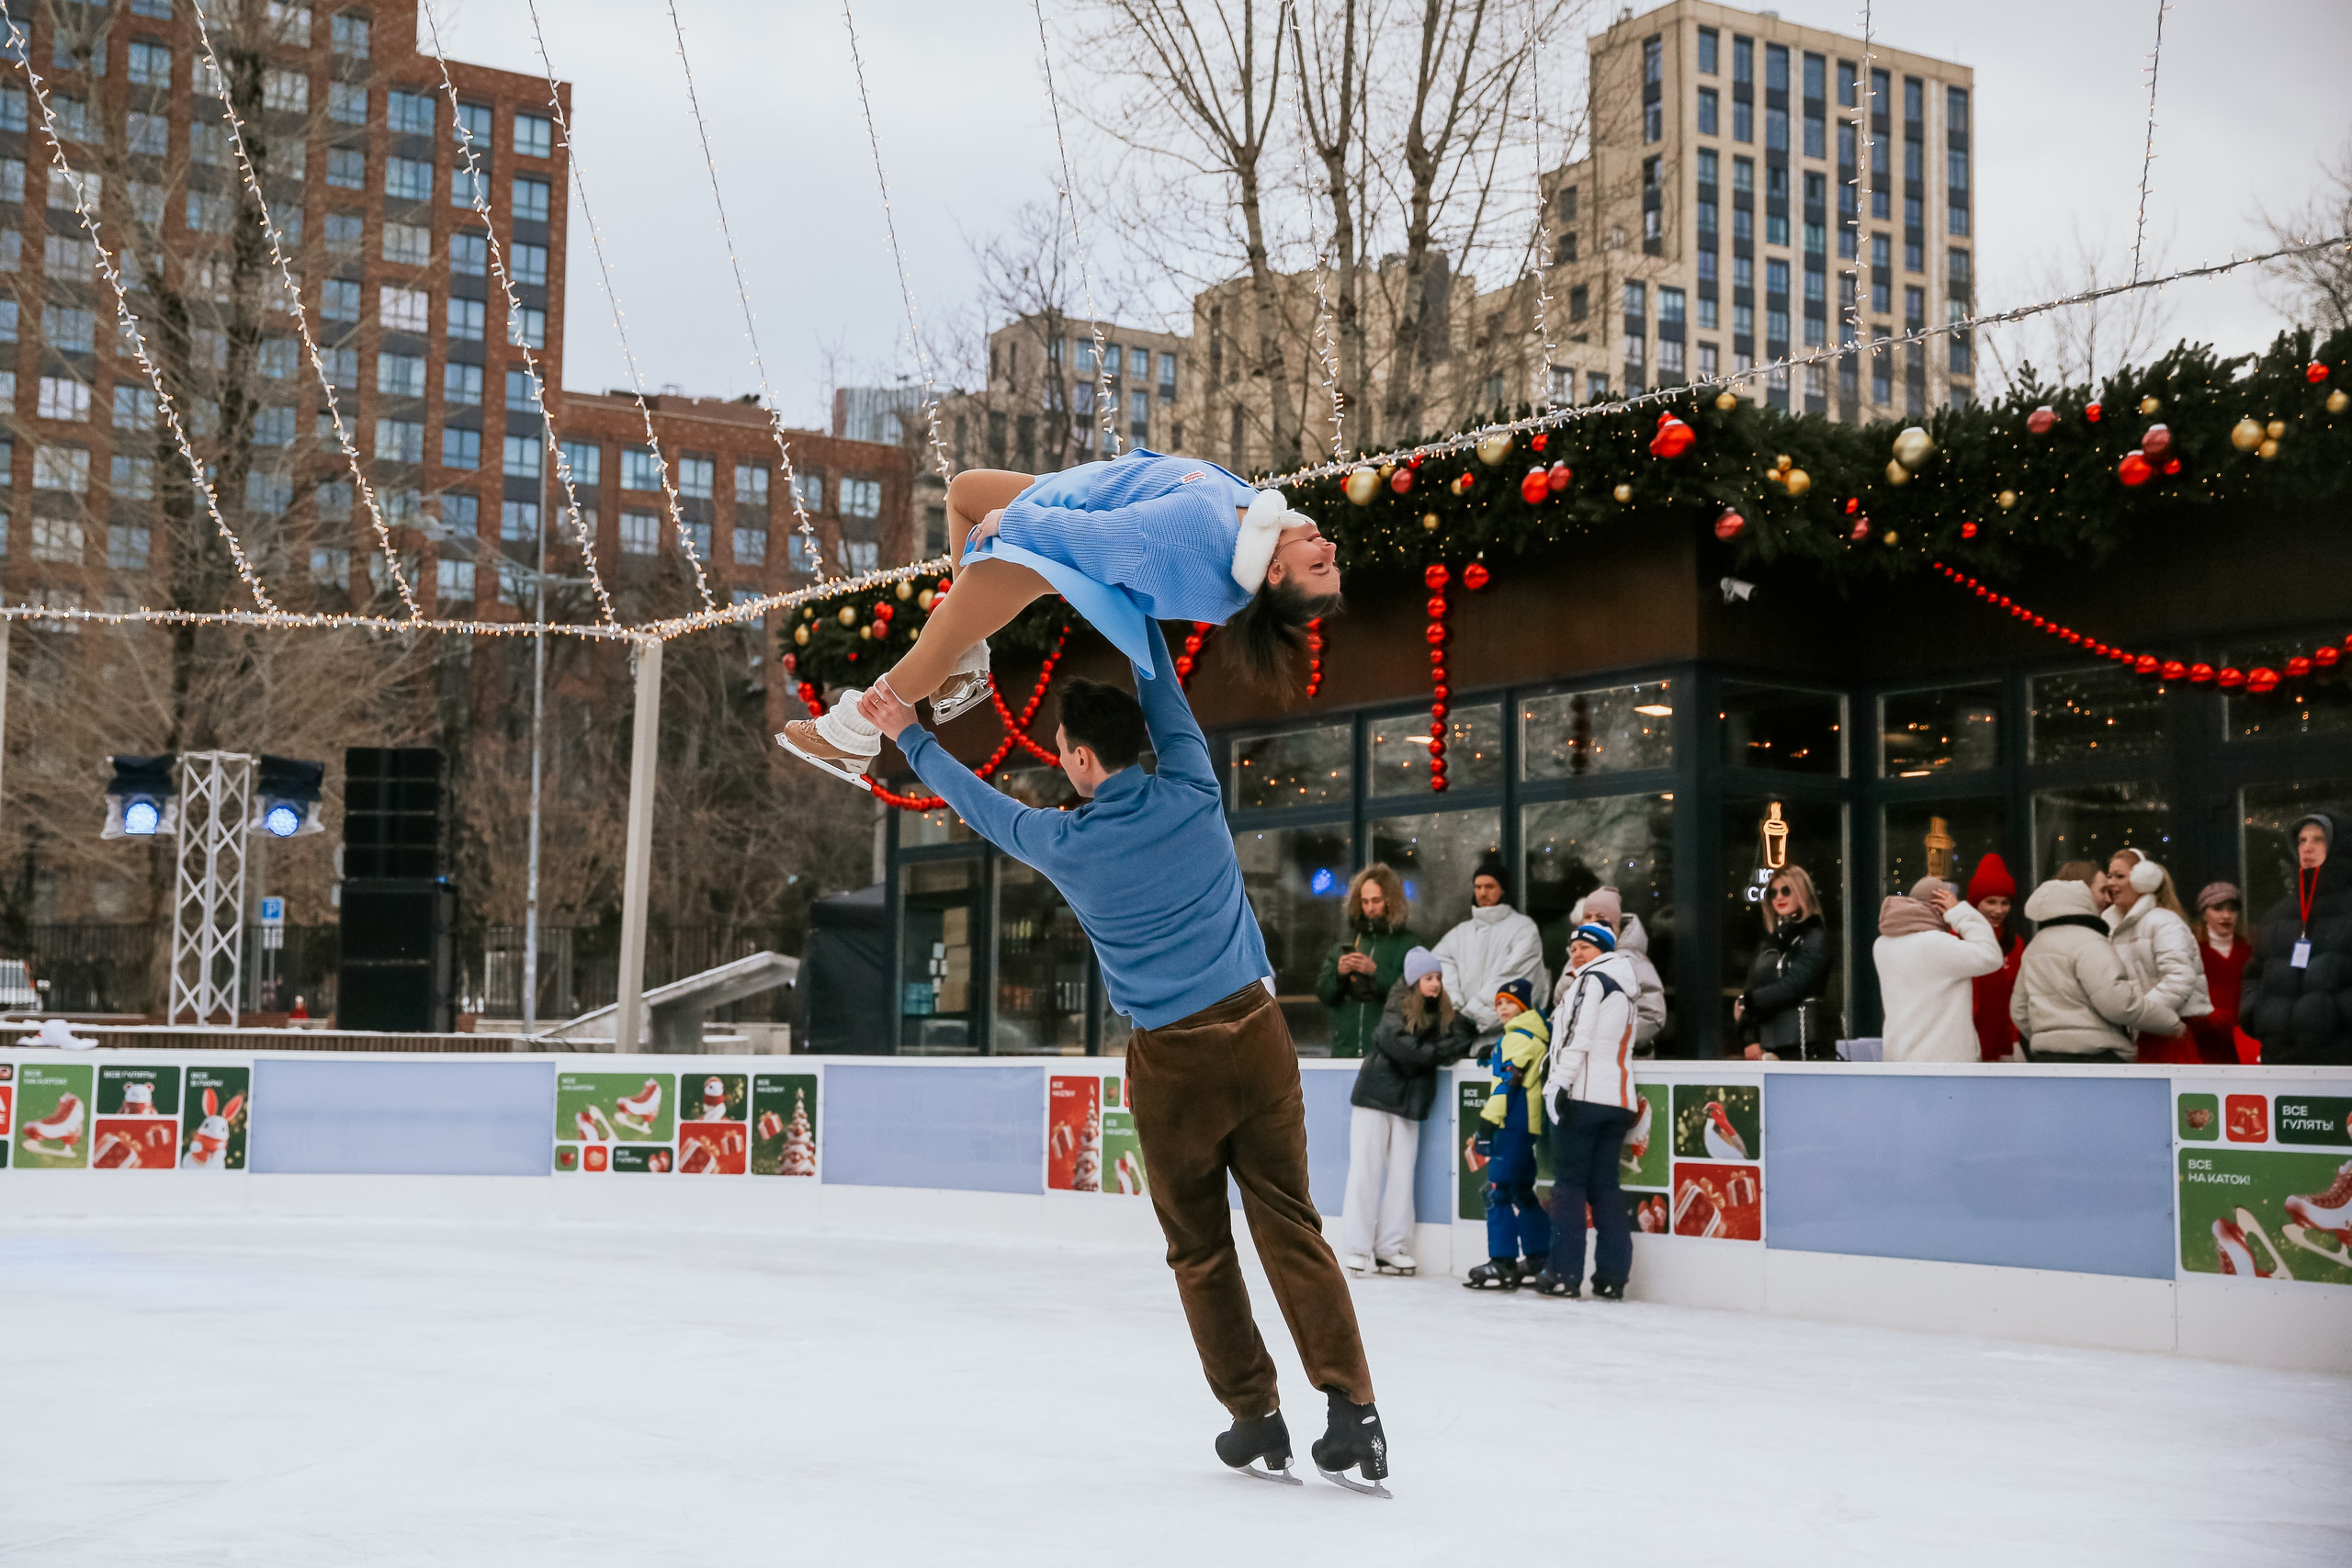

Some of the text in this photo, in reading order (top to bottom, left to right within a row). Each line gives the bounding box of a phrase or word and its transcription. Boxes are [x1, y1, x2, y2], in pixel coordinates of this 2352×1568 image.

[1464, 1089, 1478, 1097] ВСЕ
[2282, 1105, 2309, 1116] ВСЕ
[2282, 1119, 2334, 1131] ГУЛЯТЬ!
[2188, 1159, 2212, 1170] ВСЕ
[2188, 1172, 2251, 1186] НА КАТОК!
